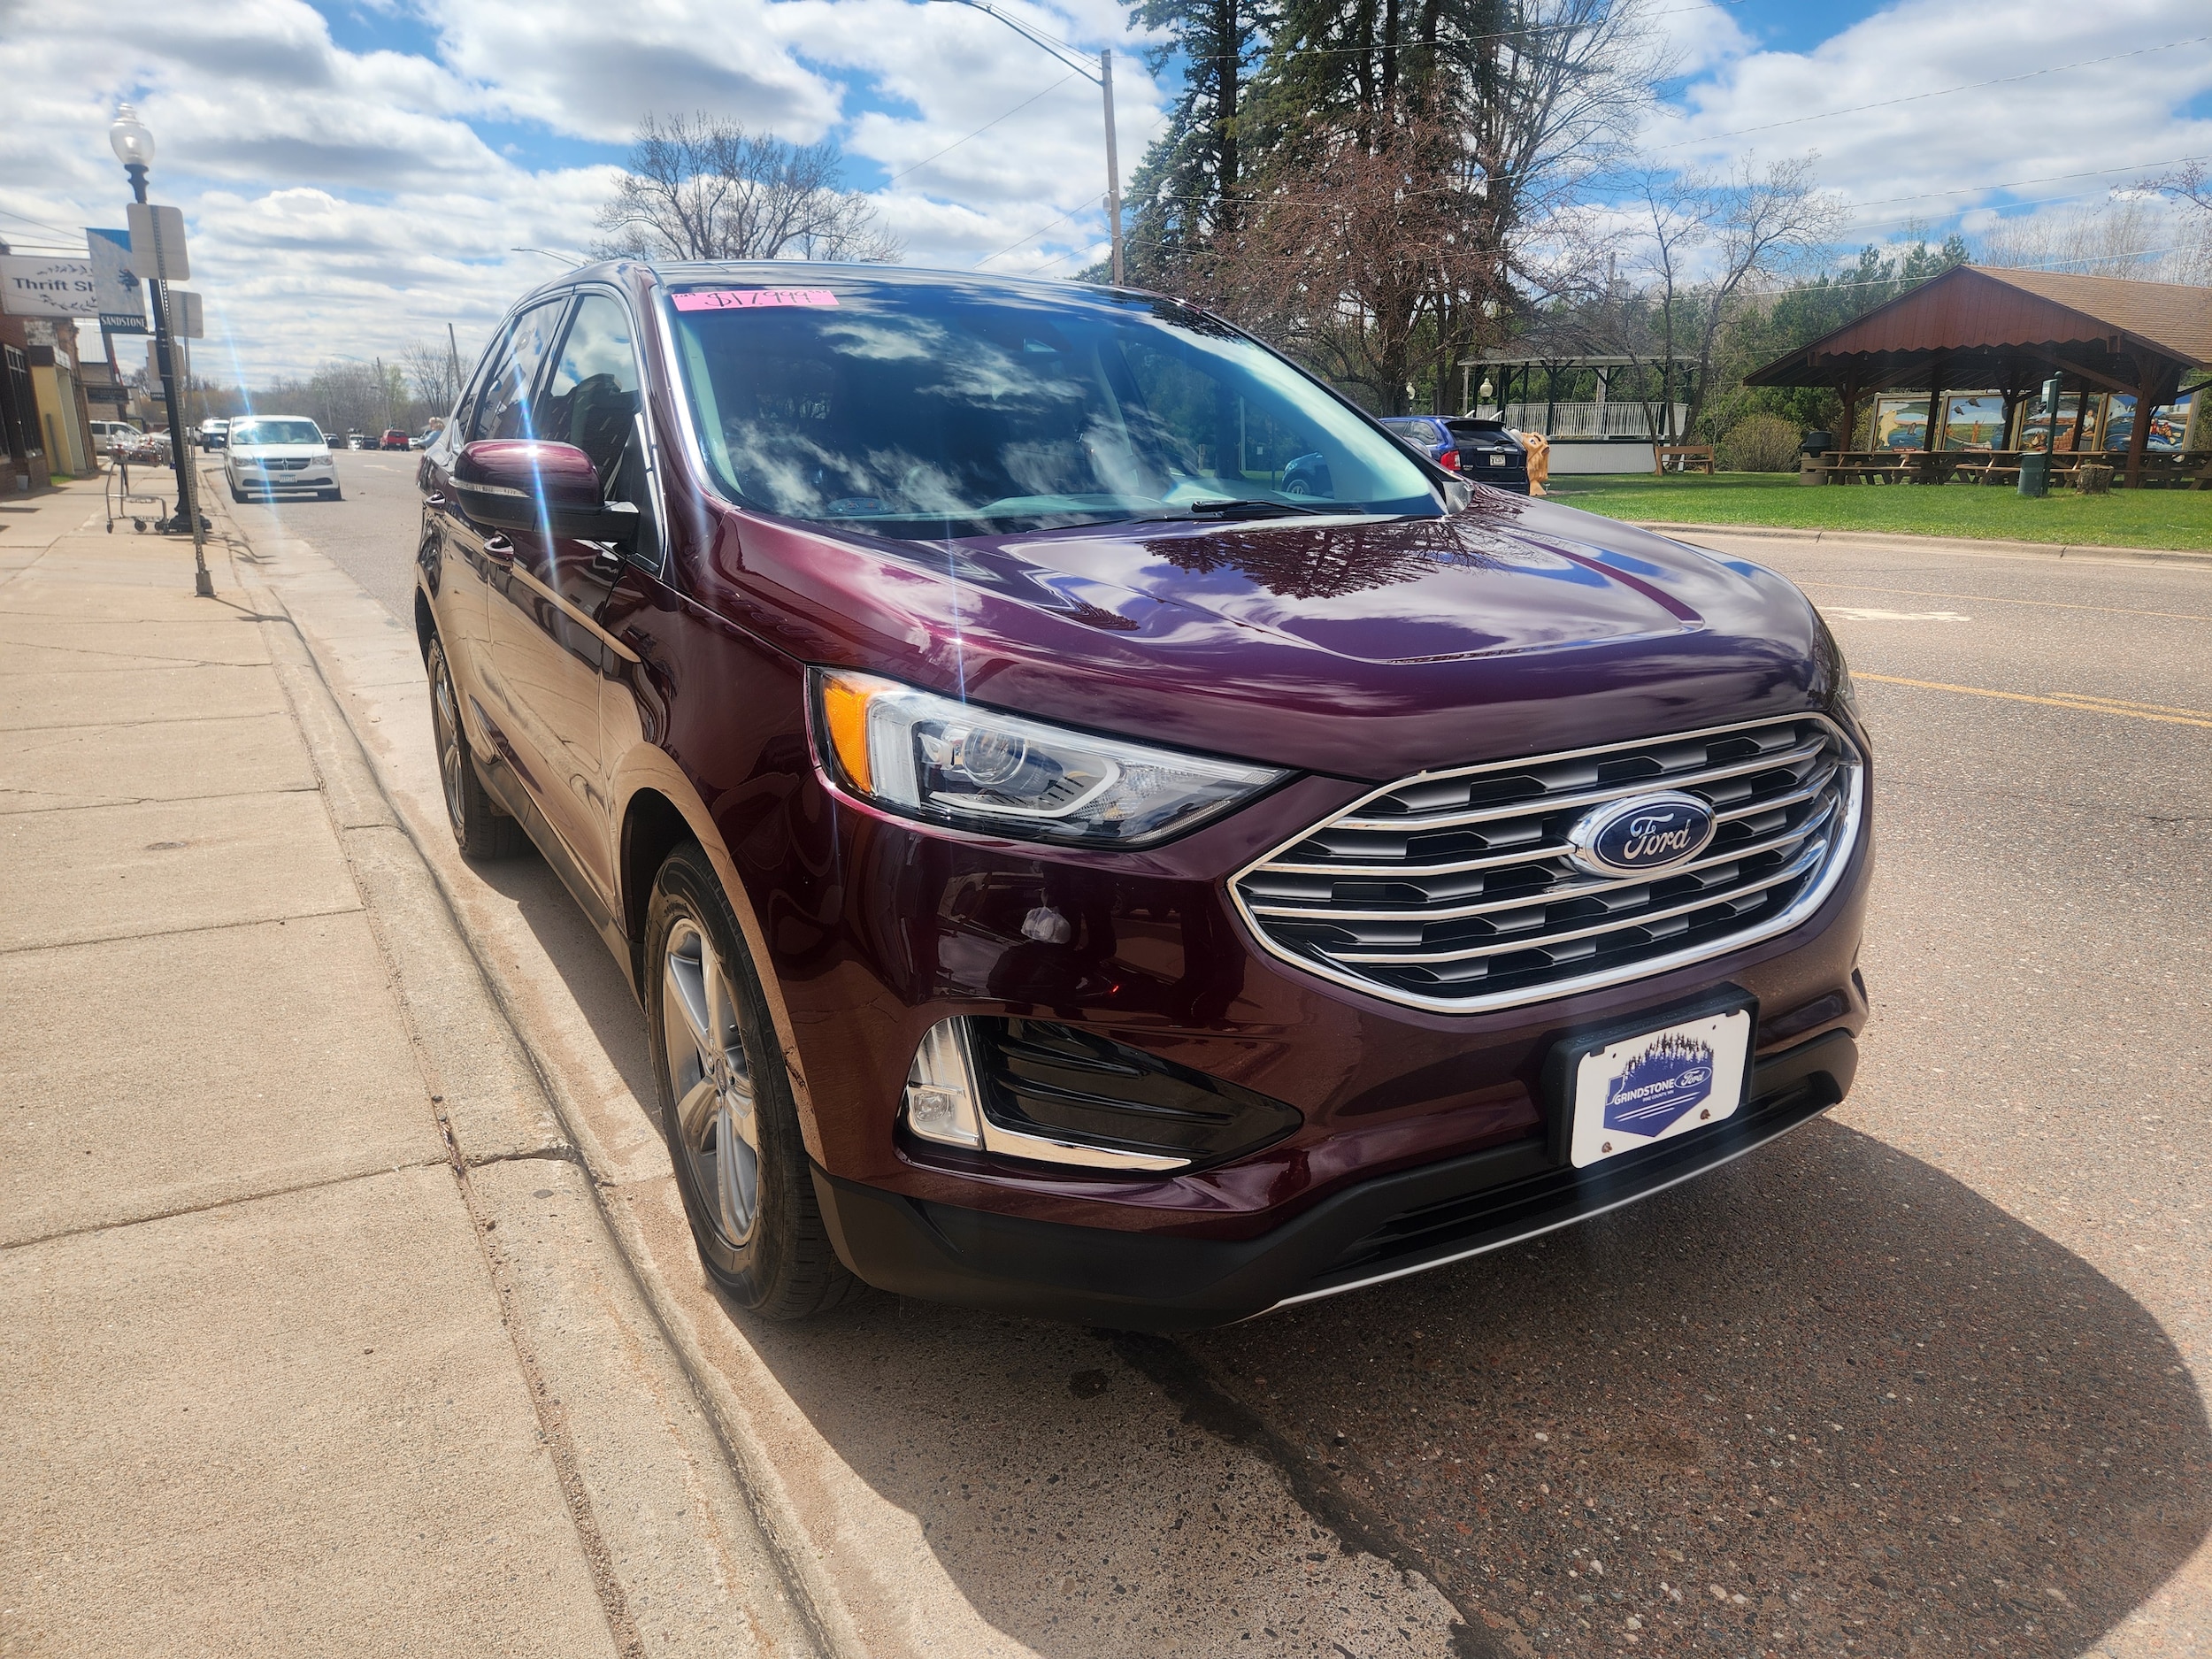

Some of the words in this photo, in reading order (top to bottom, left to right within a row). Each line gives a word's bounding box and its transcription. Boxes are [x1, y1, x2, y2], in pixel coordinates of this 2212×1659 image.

[12, 277, 69, 291] Thrift
[100, 316, 145, 327] SANDSTONE
[1624, 812, 1692, 860] Ford
[1613, 1078, 1675, 1105] GRINDSTONE
[1681, 1070, 1705, 1087] Ford
